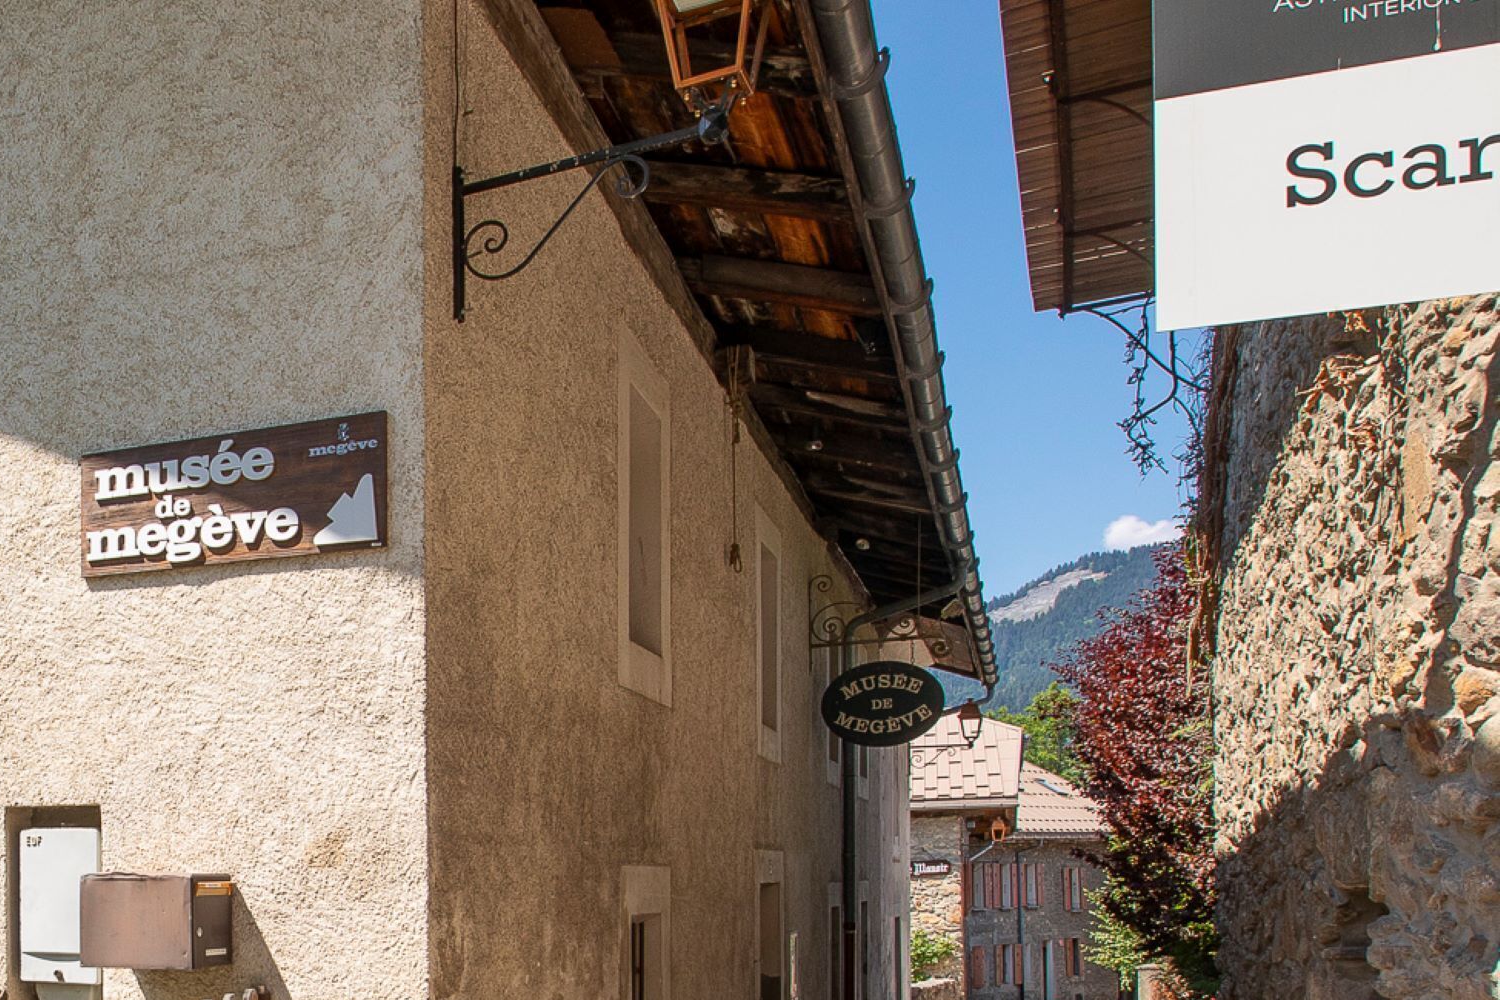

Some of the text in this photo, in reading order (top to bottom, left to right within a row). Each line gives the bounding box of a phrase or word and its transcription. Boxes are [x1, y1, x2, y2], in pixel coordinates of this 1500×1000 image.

[1343, 0, 1461, 23] INTERI
[94, 439, 274, 500] musée
[154, 495, 191, 519] de
[86, 504, 299, 563] megève
[871, 698, 893, 710] DE
